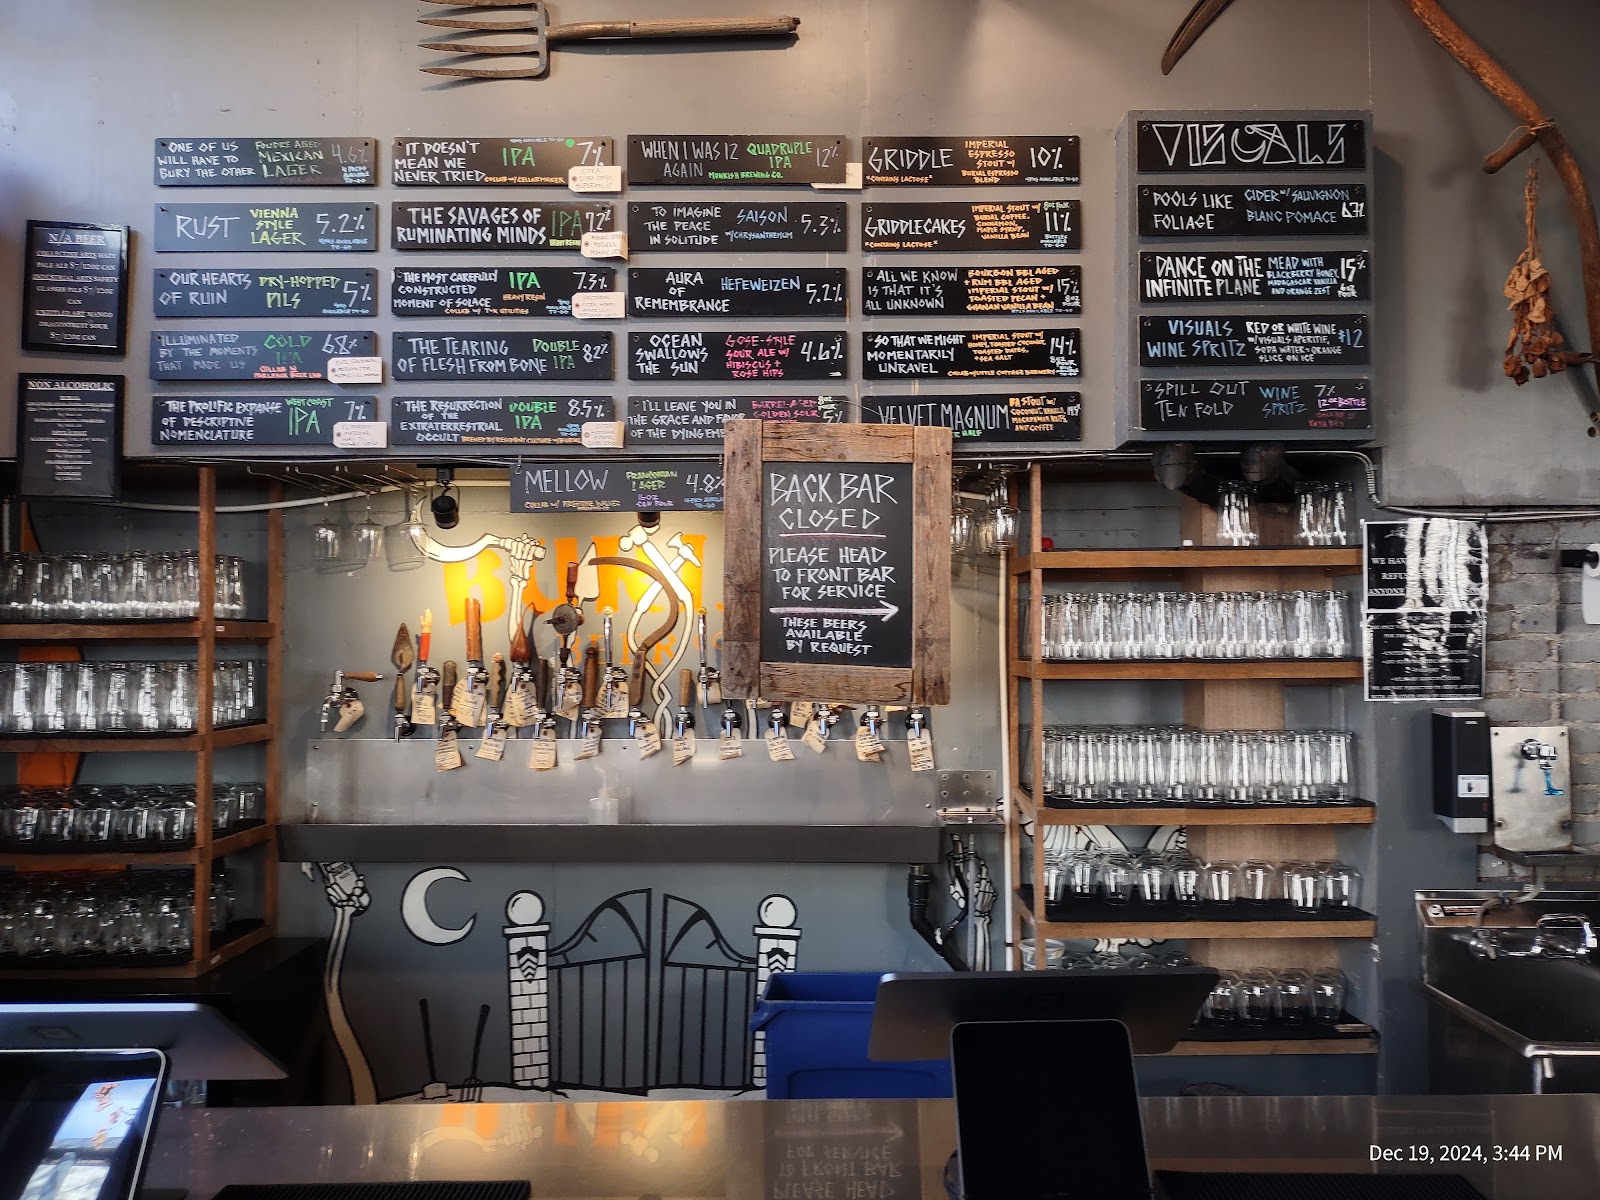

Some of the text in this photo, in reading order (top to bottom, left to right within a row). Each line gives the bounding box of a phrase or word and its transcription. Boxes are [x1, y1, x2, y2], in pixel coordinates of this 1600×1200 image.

[168, 141, 239, 153] ONE OF US
[405, 142, 419, 156] IT
[641, 140, 739, 160] WHEN WAS 12
[965, 140, 1009, 149] IMPERIAL
[157, 156, 220, 166] WILL HAVE
[502, 146, 536, 167] IPA
[868, 146, 954, 173] GRIDDLE
[968, 149, 1015, 159] ESPRESSO
[1030, 146, 1063, 170] 10%
[394, 157, 466, 169] MEAN WE
[769, 155, 792, 169] IPA
[976, 159, 1006, 169] STOUT
[394, 170, 440, 184] NEVER
[663, 162, 704, 178] AGAIN
[1153, 191, 1234, 210] POOLS LIKE
[249, 206, 298, 218] VIENNA
[407, 206, 542, 225] THE SAVAGES OF
[651, 205, 721, 218] TO IMAGINE
[971, 204, 1030, 213] IMPERIAL STOUT
[1045, 212, 1071, 231] 11%
[1153, 213, 1215, 230] FOLIAGE
[1286, 210, 1337, 223] POMACE
[175, 215, 241, 240] RUST
[256, 219, 294, 231] STYLE
[316, 213, 365, 235] 5.2%
[644, 221, 711, 231] THE PEACE
[865, 217, 966, 239] GRIDDLECAKES
[75, 236, 106, 244] BEER
[250, 231, 306, 246] LAGER
[396, 226, 547, 245] RUMINATING MINDS
[650, 234, 661, 245] IN
[1155, 255, 1264, 279] DANCE ON THE
[1300, 256, 1325, 267] WITH
[402, 271, 423, 282] THE
[900, 269, 918, 281] WE
[1035, 267, 1059, 275] AGED
[169, 272, 252, 290] OUR HEARTS
[508, 271, 541, 291] IPA
[665, 271, 704, 286] AURA
[720, 275, 801, 291] HEFEWEIZEN
[1015, 277, 1043, 286] AGED
[159, 289, 228, 305] OF RUIN
[668, 287, 686, 297] OF
[806, 283, 843, 304] 5.2%
[1011, 286, 1040, 294] STOUT
[266, 292, 301, 309] PILS
[393, 297, 492, 308] MOMENT OF SOLACE
[634, 296, 730, 313] REMEMBRANCE
[865, 299, 882, 310] ALL
[1168, 320, 1234, 337] VISUALS
[1271, 323, 1285, 334] OR
[263, 334, 312, 349] COLD
[649, 332, 703, 348] OCEAN
[874, 334, 966, 348] SO THAT WE MIGHT
[972, 333, 1010, 341] IMPERIAL
[407, 337, 508, 356] THE TEARING
[532, 338, 580, 353] DOUBLE
[756, 348, 776, 357] ALE
[160, 348, 202, 358] BY THE
[635, 347, 709, 363] SWALLOWS
[1286, 354, 1315, 362] ON ICE
[157, 360, 220, 371] THAT MADE
[397, 357, 417, 373] OF
[421, 355, 466, 375] FLESH
[731, 369, 784, 379] ROSE HIPS
[54, 381, 115, 391] ALCOHOLIC
[1154, 381, 1250, 399] SPILL OUT
[1259, 385, 1299, 400] WINE
[165, 401, 187, 413] THE
[403, 400, 427, 413] THE
[664, 399, 737, 412] LEAVE IN
[1020, 396, 1046, 406] STOUT
[421, 410, 459, 420] OF THE
[941, 403, 1010, 430] MAGNUM
[1154, 400, 1188, 421] TEN
[161, 417, 254, 428] OF DESCRIPTIVE
[288, 406, 321, 436] IPA
[400, 421, 503, 432] EXTRATERRESTRIAL
[627, 415, 715, 425] THE GRACE AND
[159, 430, 254, 441] NOMENCLATURE
[415, 432, 460, 442] OCCULT
[524, 469, 609, 494] MELLOW
[631, 481, 666, 492] LAGER
[770, 472, 898, 506] BACK BAR
[779, 507, 880, 531] CLOSED
[768, 546, 888, 566] PLEASE HEAD
[772, 566, 896, 584] TO FRONT BAR
[782, 584, 886, 601] FOR SERVICE
[780, 616, 868, 632] THESE BEERS
[785, 629, 863, 642] AVAILABLE
[786, 639, 874, 657] BY REQUEST
